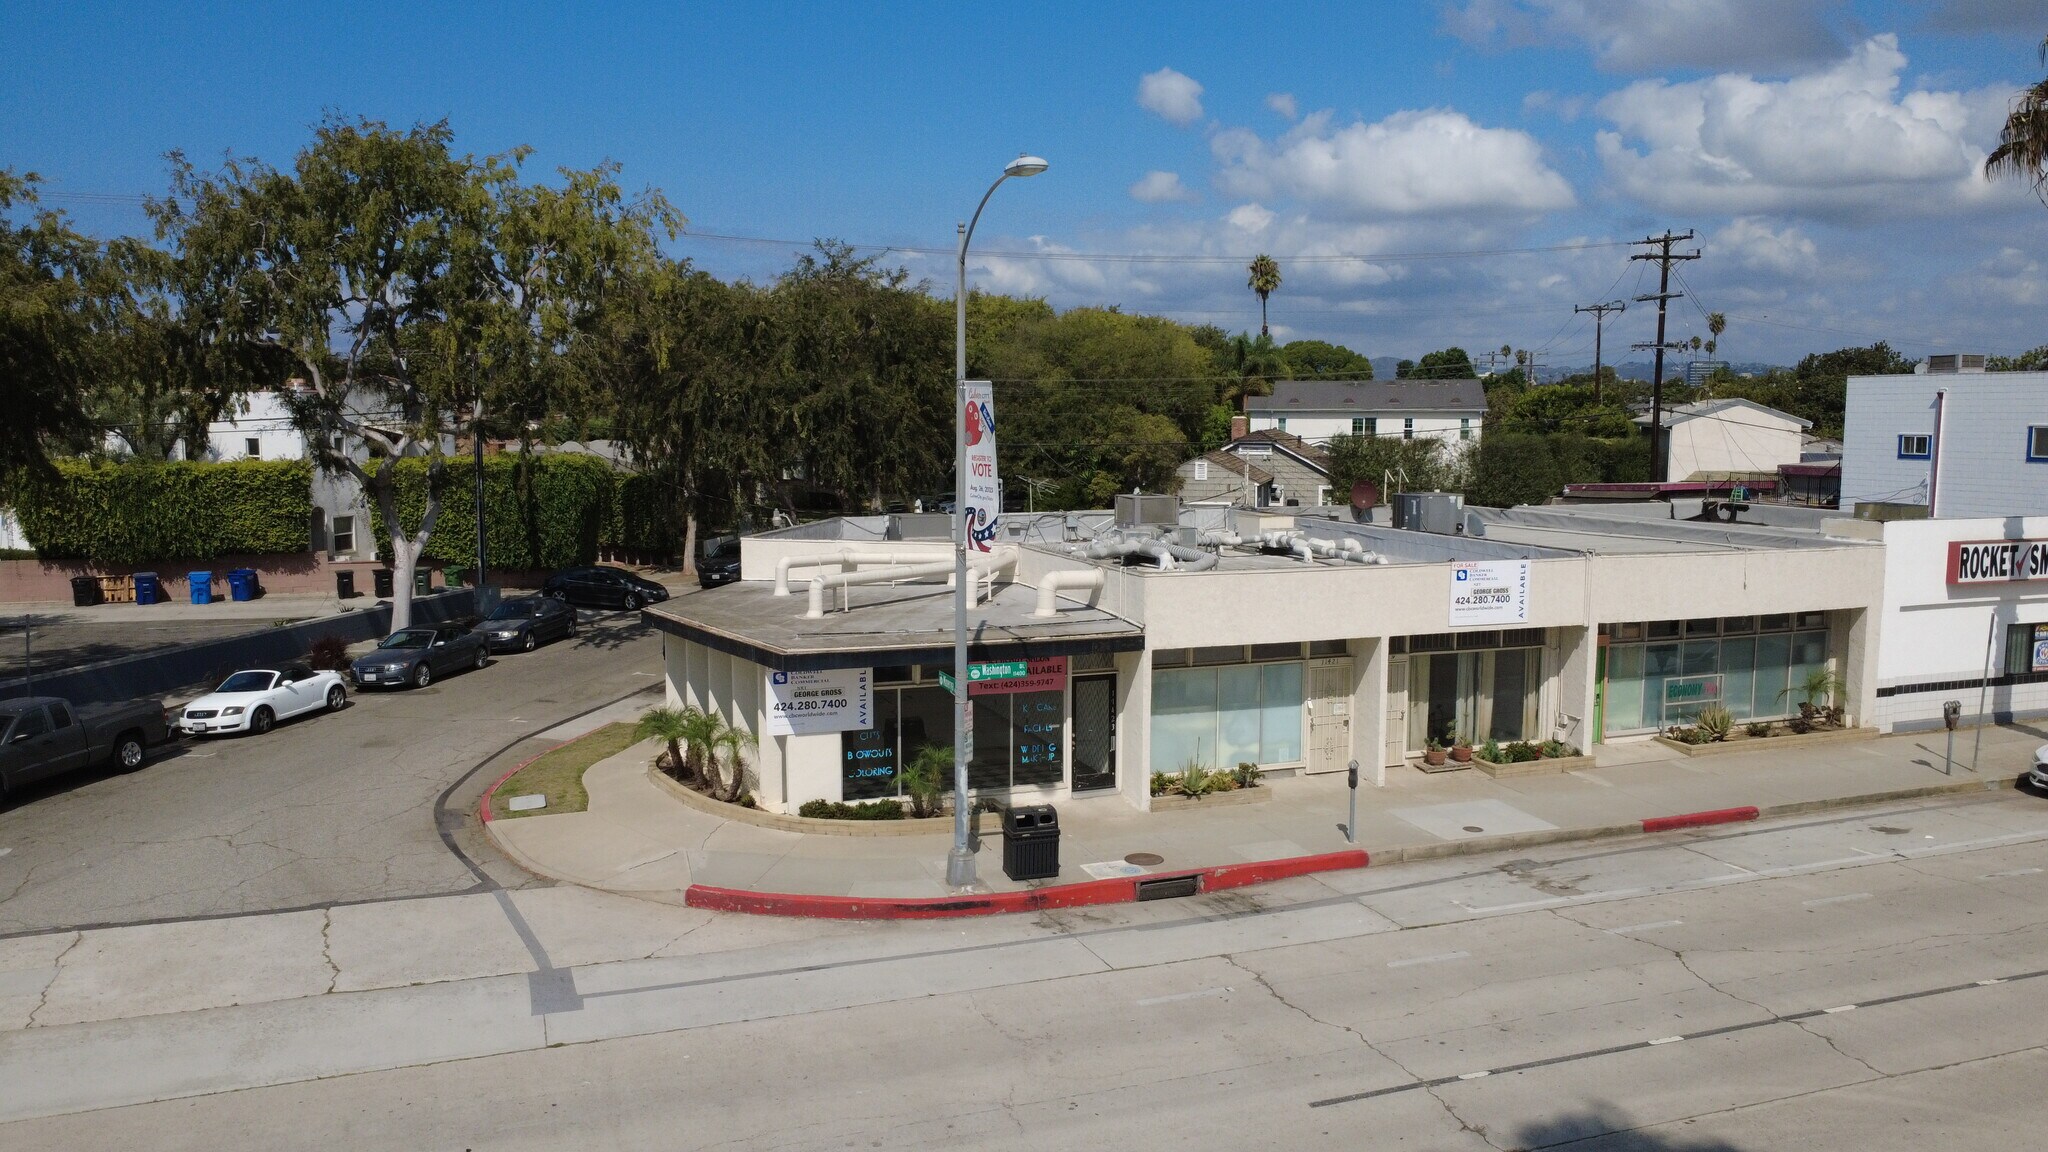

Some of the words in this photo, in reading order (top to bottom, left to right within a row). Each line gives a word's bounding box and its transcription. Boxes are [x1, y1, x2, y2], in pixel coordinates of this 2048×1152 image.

[972, 463, 992, 477] VOTE
[1960, 545, 2019, 579] ROCKET
[1518, 563, 1527, 618] AVAILABLE
[1455, 595, 1510, 605] 424.280.7400
[982, 664, 1011, 678] Washington
[1027, 665, 1063, 675] AILABLE
[794, 690, 819, 698] GEORGE
[820, 688, 842, 696] GROSS
[979, 682, 999, 690] Text:
[1668, 683, 1703, 698] ECONOMY
[859, 670, 867, 725] AVAILABL
[774, 699, 848, 711] 424.280.7400
